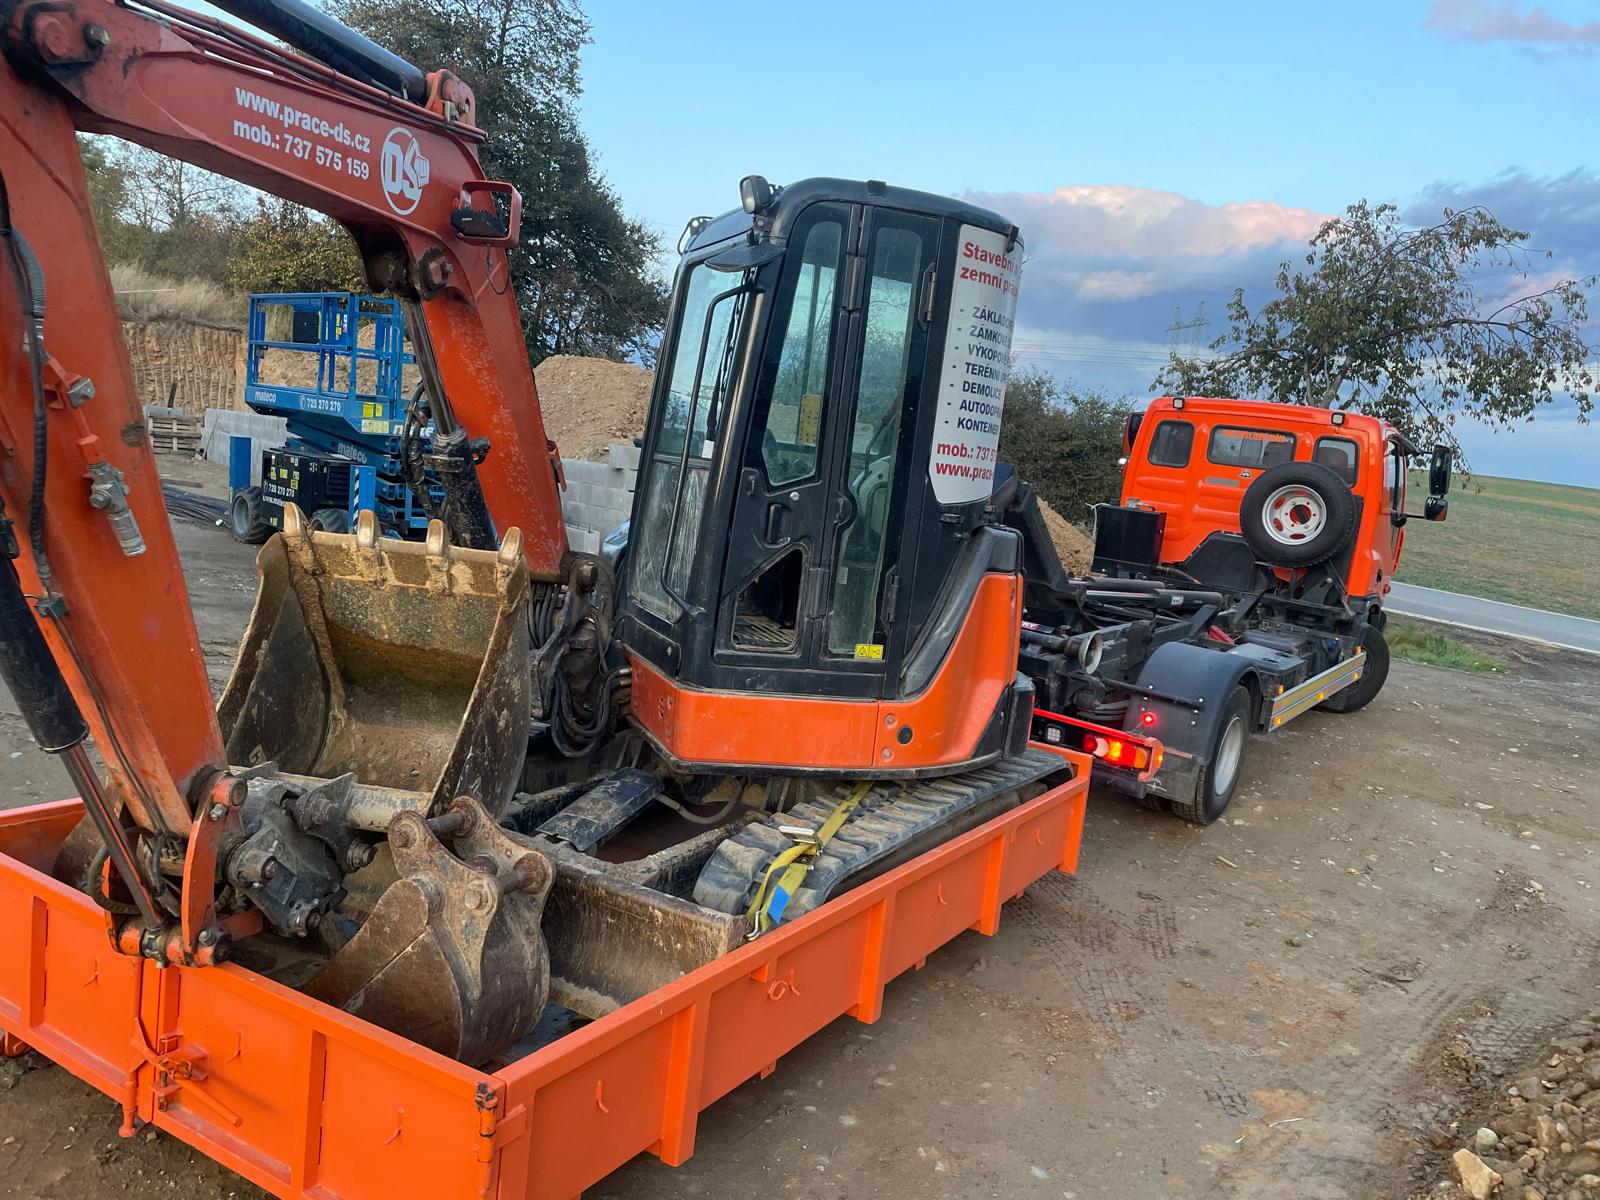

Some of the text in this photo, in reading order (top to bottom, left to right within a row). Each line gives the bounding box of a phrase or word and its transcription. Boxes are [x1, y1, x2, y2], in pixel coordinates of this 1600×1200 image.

[235, 86, 371, 154] www.prace-ds.cz
[233, 119, 369, 180] mob.: 737 575 159
[960, 266, 1003, 288] zemní
[318, 399, 329, 410] 270
[329, 400, 341, 412] 270
[337, 442, 367, 464] mateco
[937, 443, 974, 458] mob.:
[976, 445, 990, 461] 737
